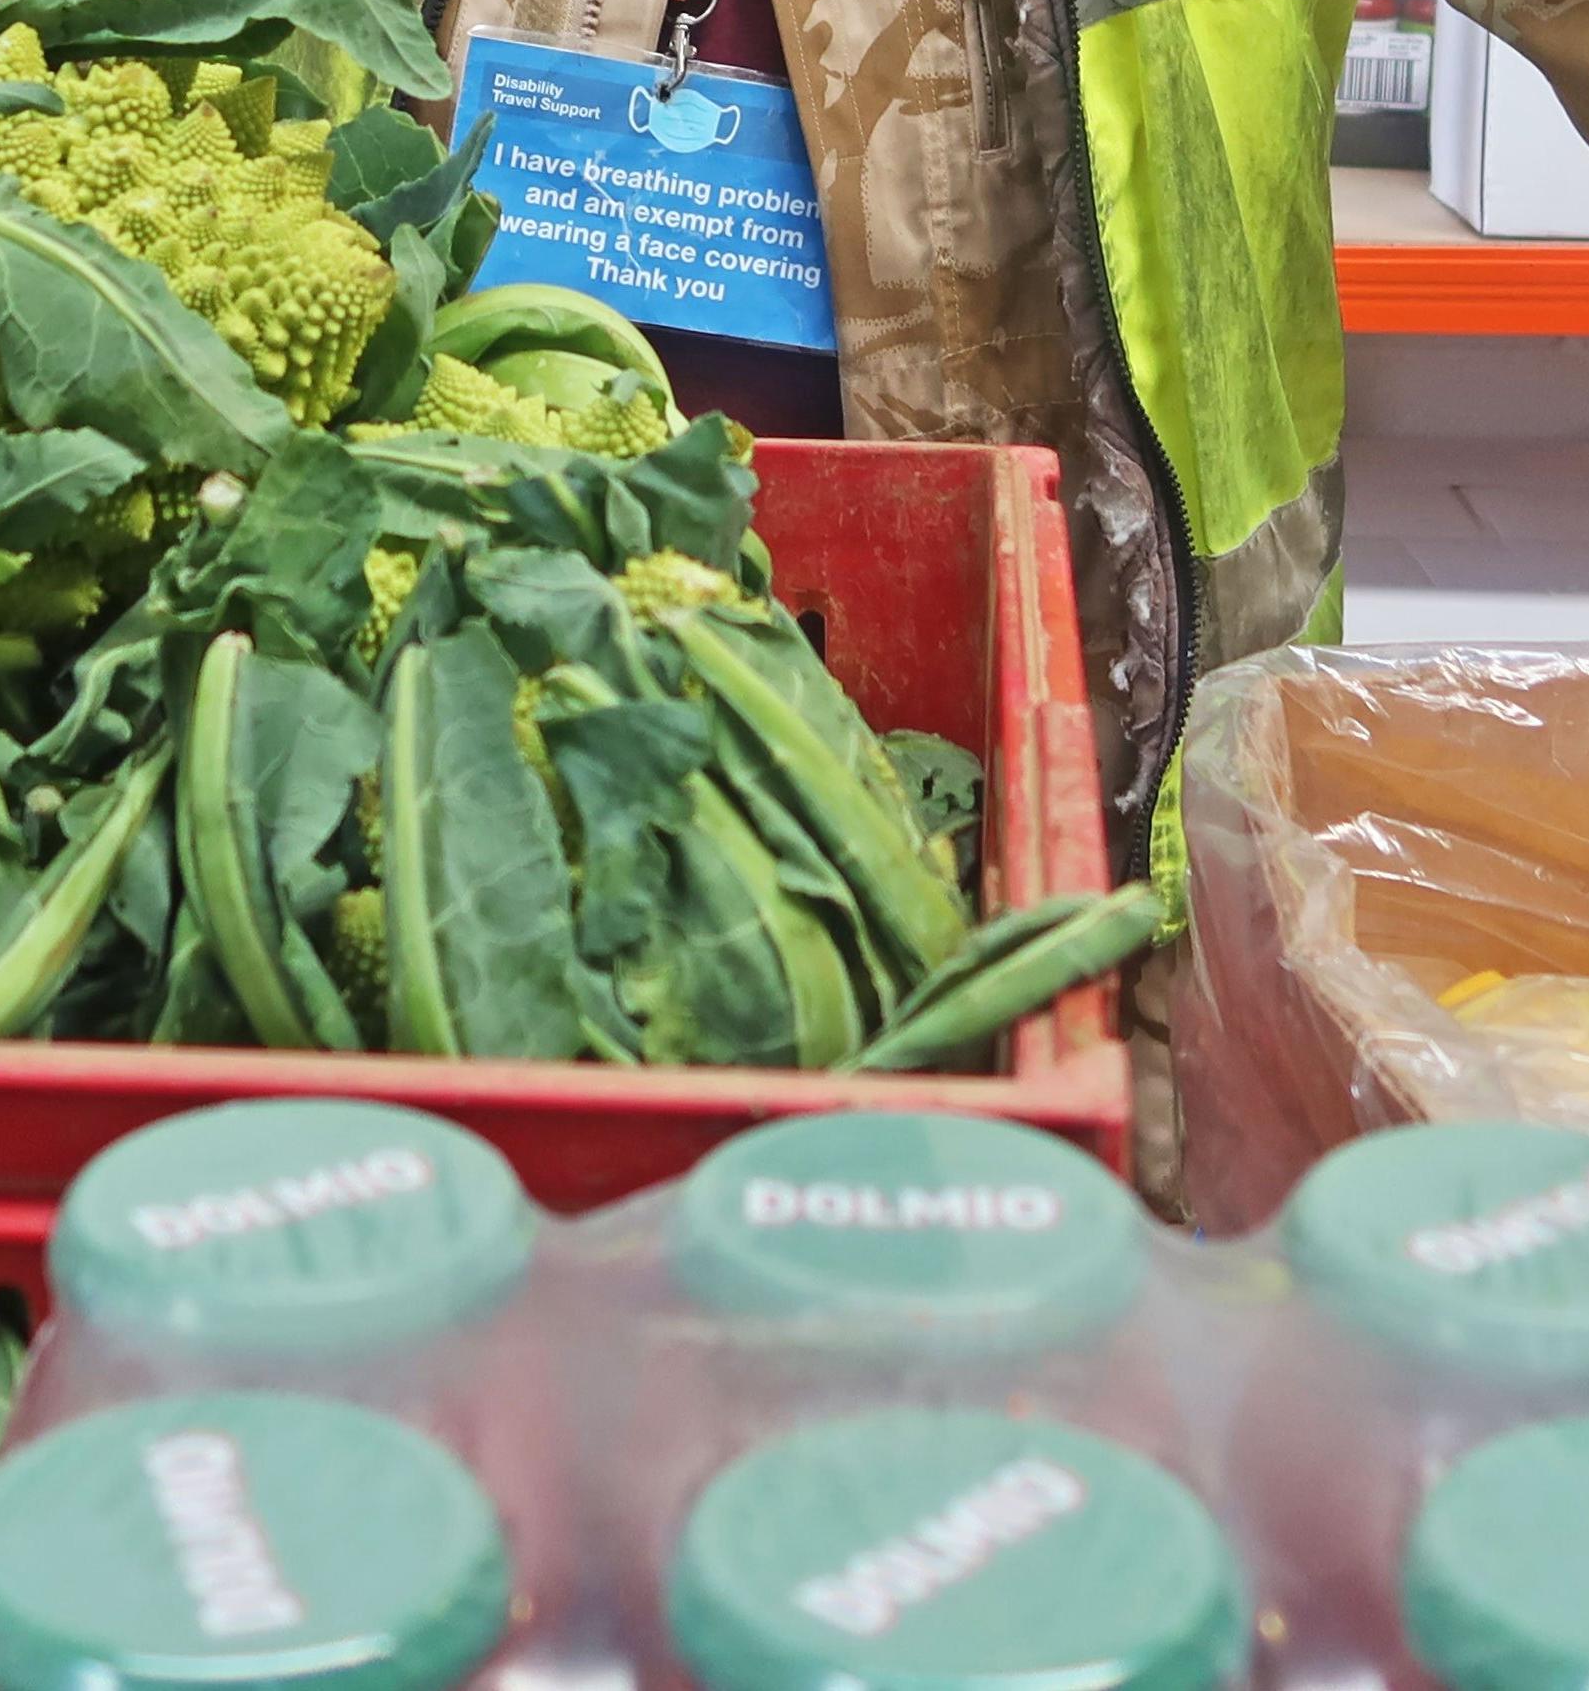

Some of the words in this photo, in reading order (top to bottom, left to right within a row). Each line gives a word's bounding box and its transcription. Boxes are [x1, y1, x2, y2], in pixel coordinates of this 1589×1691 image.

[492, 89, 537, 109] Travel
[540, 98, 601, 121] Support
[494, 73, 564, 98] Disability
[494, 143, 504, 165] I
[511, 146, 575, 177] have
[584, 158, 712, 206] breathing
[525, 183, 577, 211] and
[583, 196, 626, 219] am
[634, 203, 735, 239] exempt
[741, 217, 805, 250] from
[499, 214, 607, 251] wearing
[614, 232, 631, 253] a
[639, 234, 697, 264] face
[703, 245, 822, 289] covering
[586, 256, 668, 293] Thank
[674, 275, 726, 302] you
[129, 1147, 433, 1250] DOLMIO
[742, 1176, 1062, 1232] DOLMIO
[797, 1457, 1087, 1637] DOLMIO
